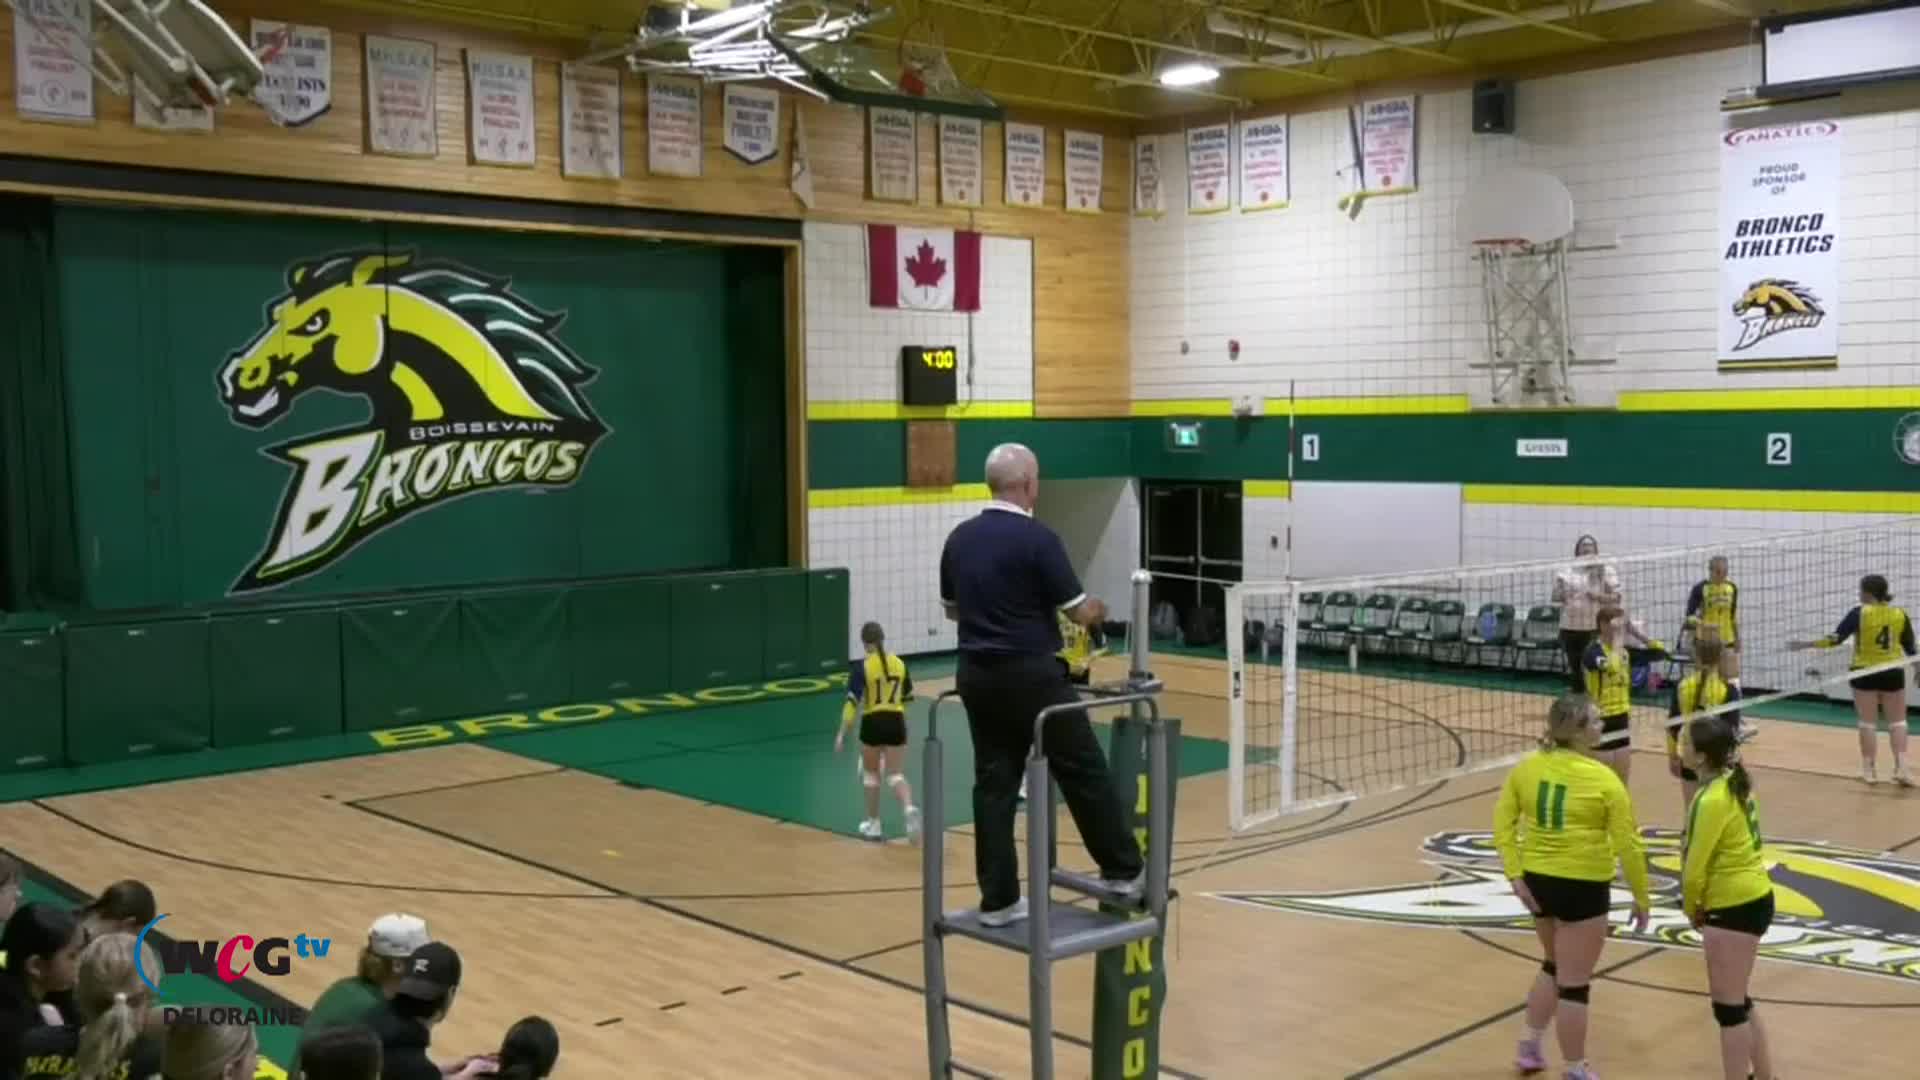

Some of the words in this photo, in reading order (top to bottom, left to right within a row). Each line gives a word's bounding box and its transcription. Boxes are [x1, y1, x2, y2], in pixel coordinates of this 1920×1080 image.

[1735, 125, 1826, 143] FANATICS
[1752, 172, 1806, 187] SPONSOR
[1760, 163, 1799, 174] PROUD
[1771, 185, 1786, 195] OF
[1736, 213, 1824, 237] BRONCO
[1725, 234, 1834, 259] ATHLETICS
[409, 422, 555, 441] BOISSEVAIN
[1770, 437, 1788, 462] 2
[256, 429, 586, 579] BRONCOS
[1874, 624, 1891, 651] 4
[874, 674, 901, 705] 17
[1535, 780, 1568, 832] 11
